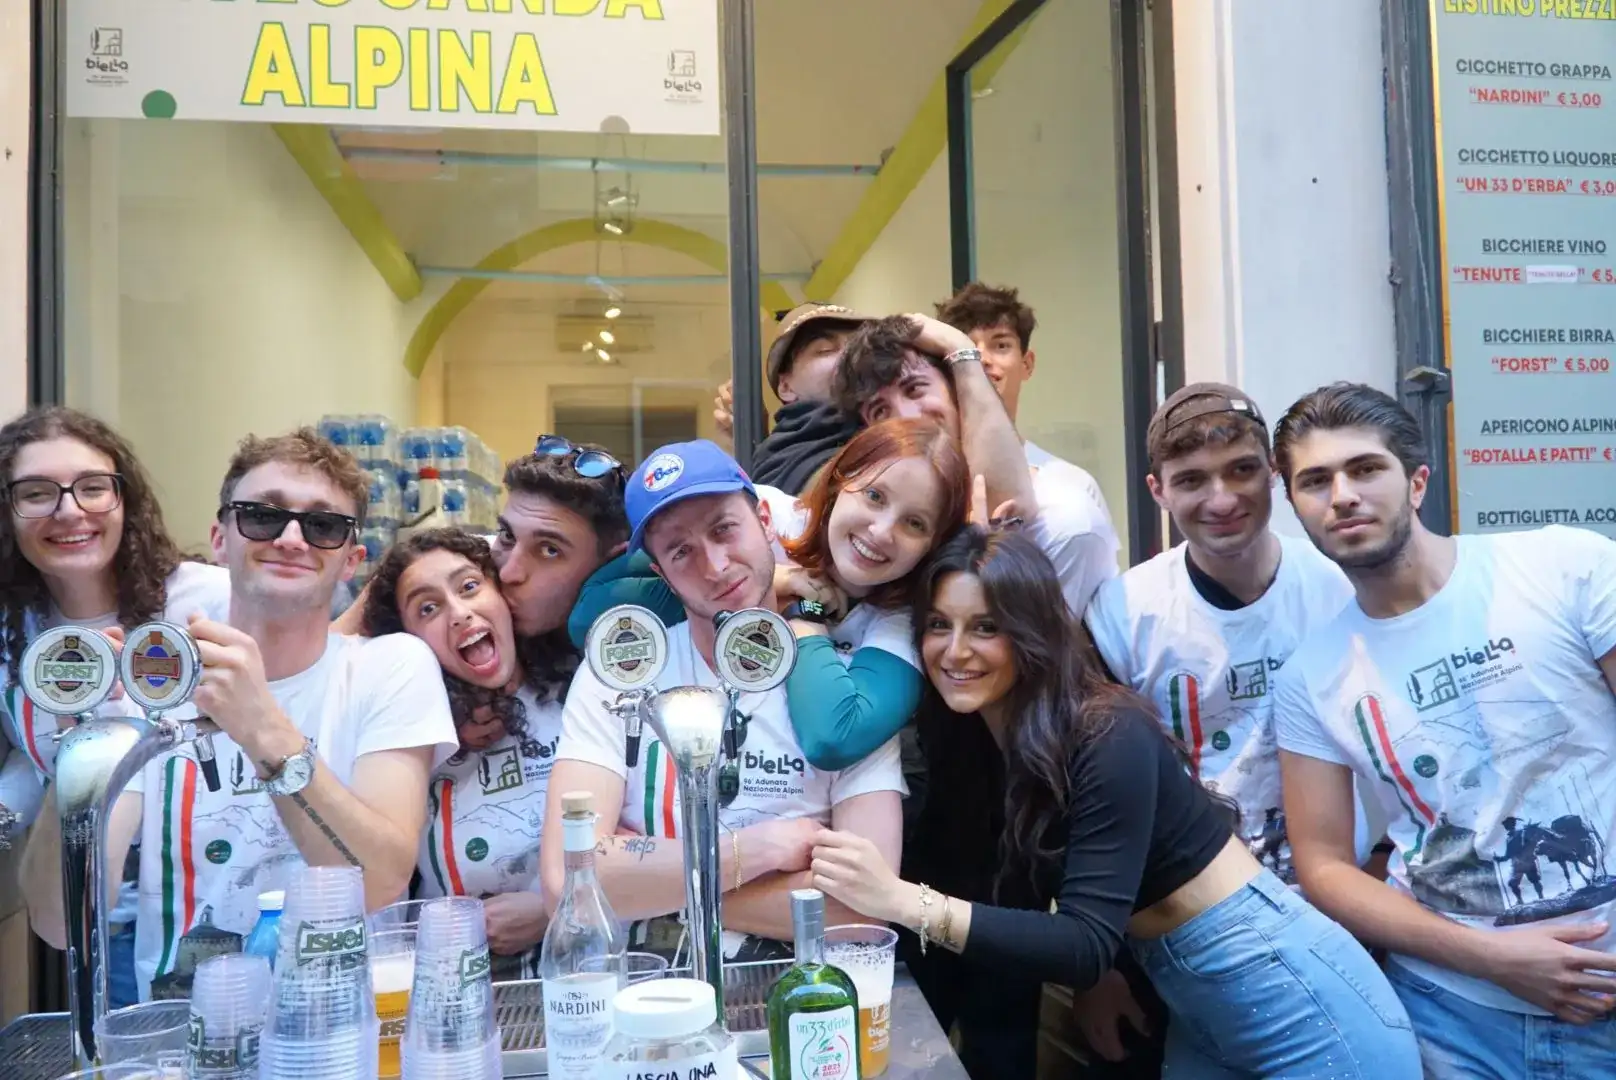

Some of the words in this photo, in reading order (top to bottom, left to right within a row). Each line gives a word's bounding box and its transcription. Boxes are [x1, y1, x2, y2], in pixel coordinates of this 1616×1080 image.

[241, 21, 558, 115] ALPINA
[1456, 59, 1546, 76] CICCHETTO
[1550, 63, 1612, 79] GRAPPA
[1557, 93, 1566, 105] €
[1570, 93, 1601, 107] 3,00
[1458, 149, 1549, 164] CICCHETTO
[1553, 151, 1616, 166] LIQUORE
[1492, 178, 1508, 191] 33
[1580, 180, 1589, 193] €
[1592, 180, 1616, 196] 3,0
[1482, 239, 1564, 253] BICCHIERE
[1568, 240, 1606, 254] VINO
[1592, 269, 1601, 281] €
[1483, 329, 1565, 343] BICCHIERE
[1570, 329, 1615, 343] BIRRA
[1564, 359, 1573, 371] €
[1577, 359, 1609, 373] 5,00
[1480, 418, 1569, 433] APERICONO
[1540, 448, 1547, 462] E
[1603, 448, 1612, 461] €
[1477, 509, 1580, 525] BOTTIGLIETTA
[605, 643, 649, 662] FORST
[733, 639, 778, 664] FORST
[43, 664, 98, 679] FORST
[755, 778, 788, 786] Adunata
[743, 785, 782, 793] Nazionale
[783, 787, 804, 795] Alpini
[550, 999, 606, 1015] NARDINI
